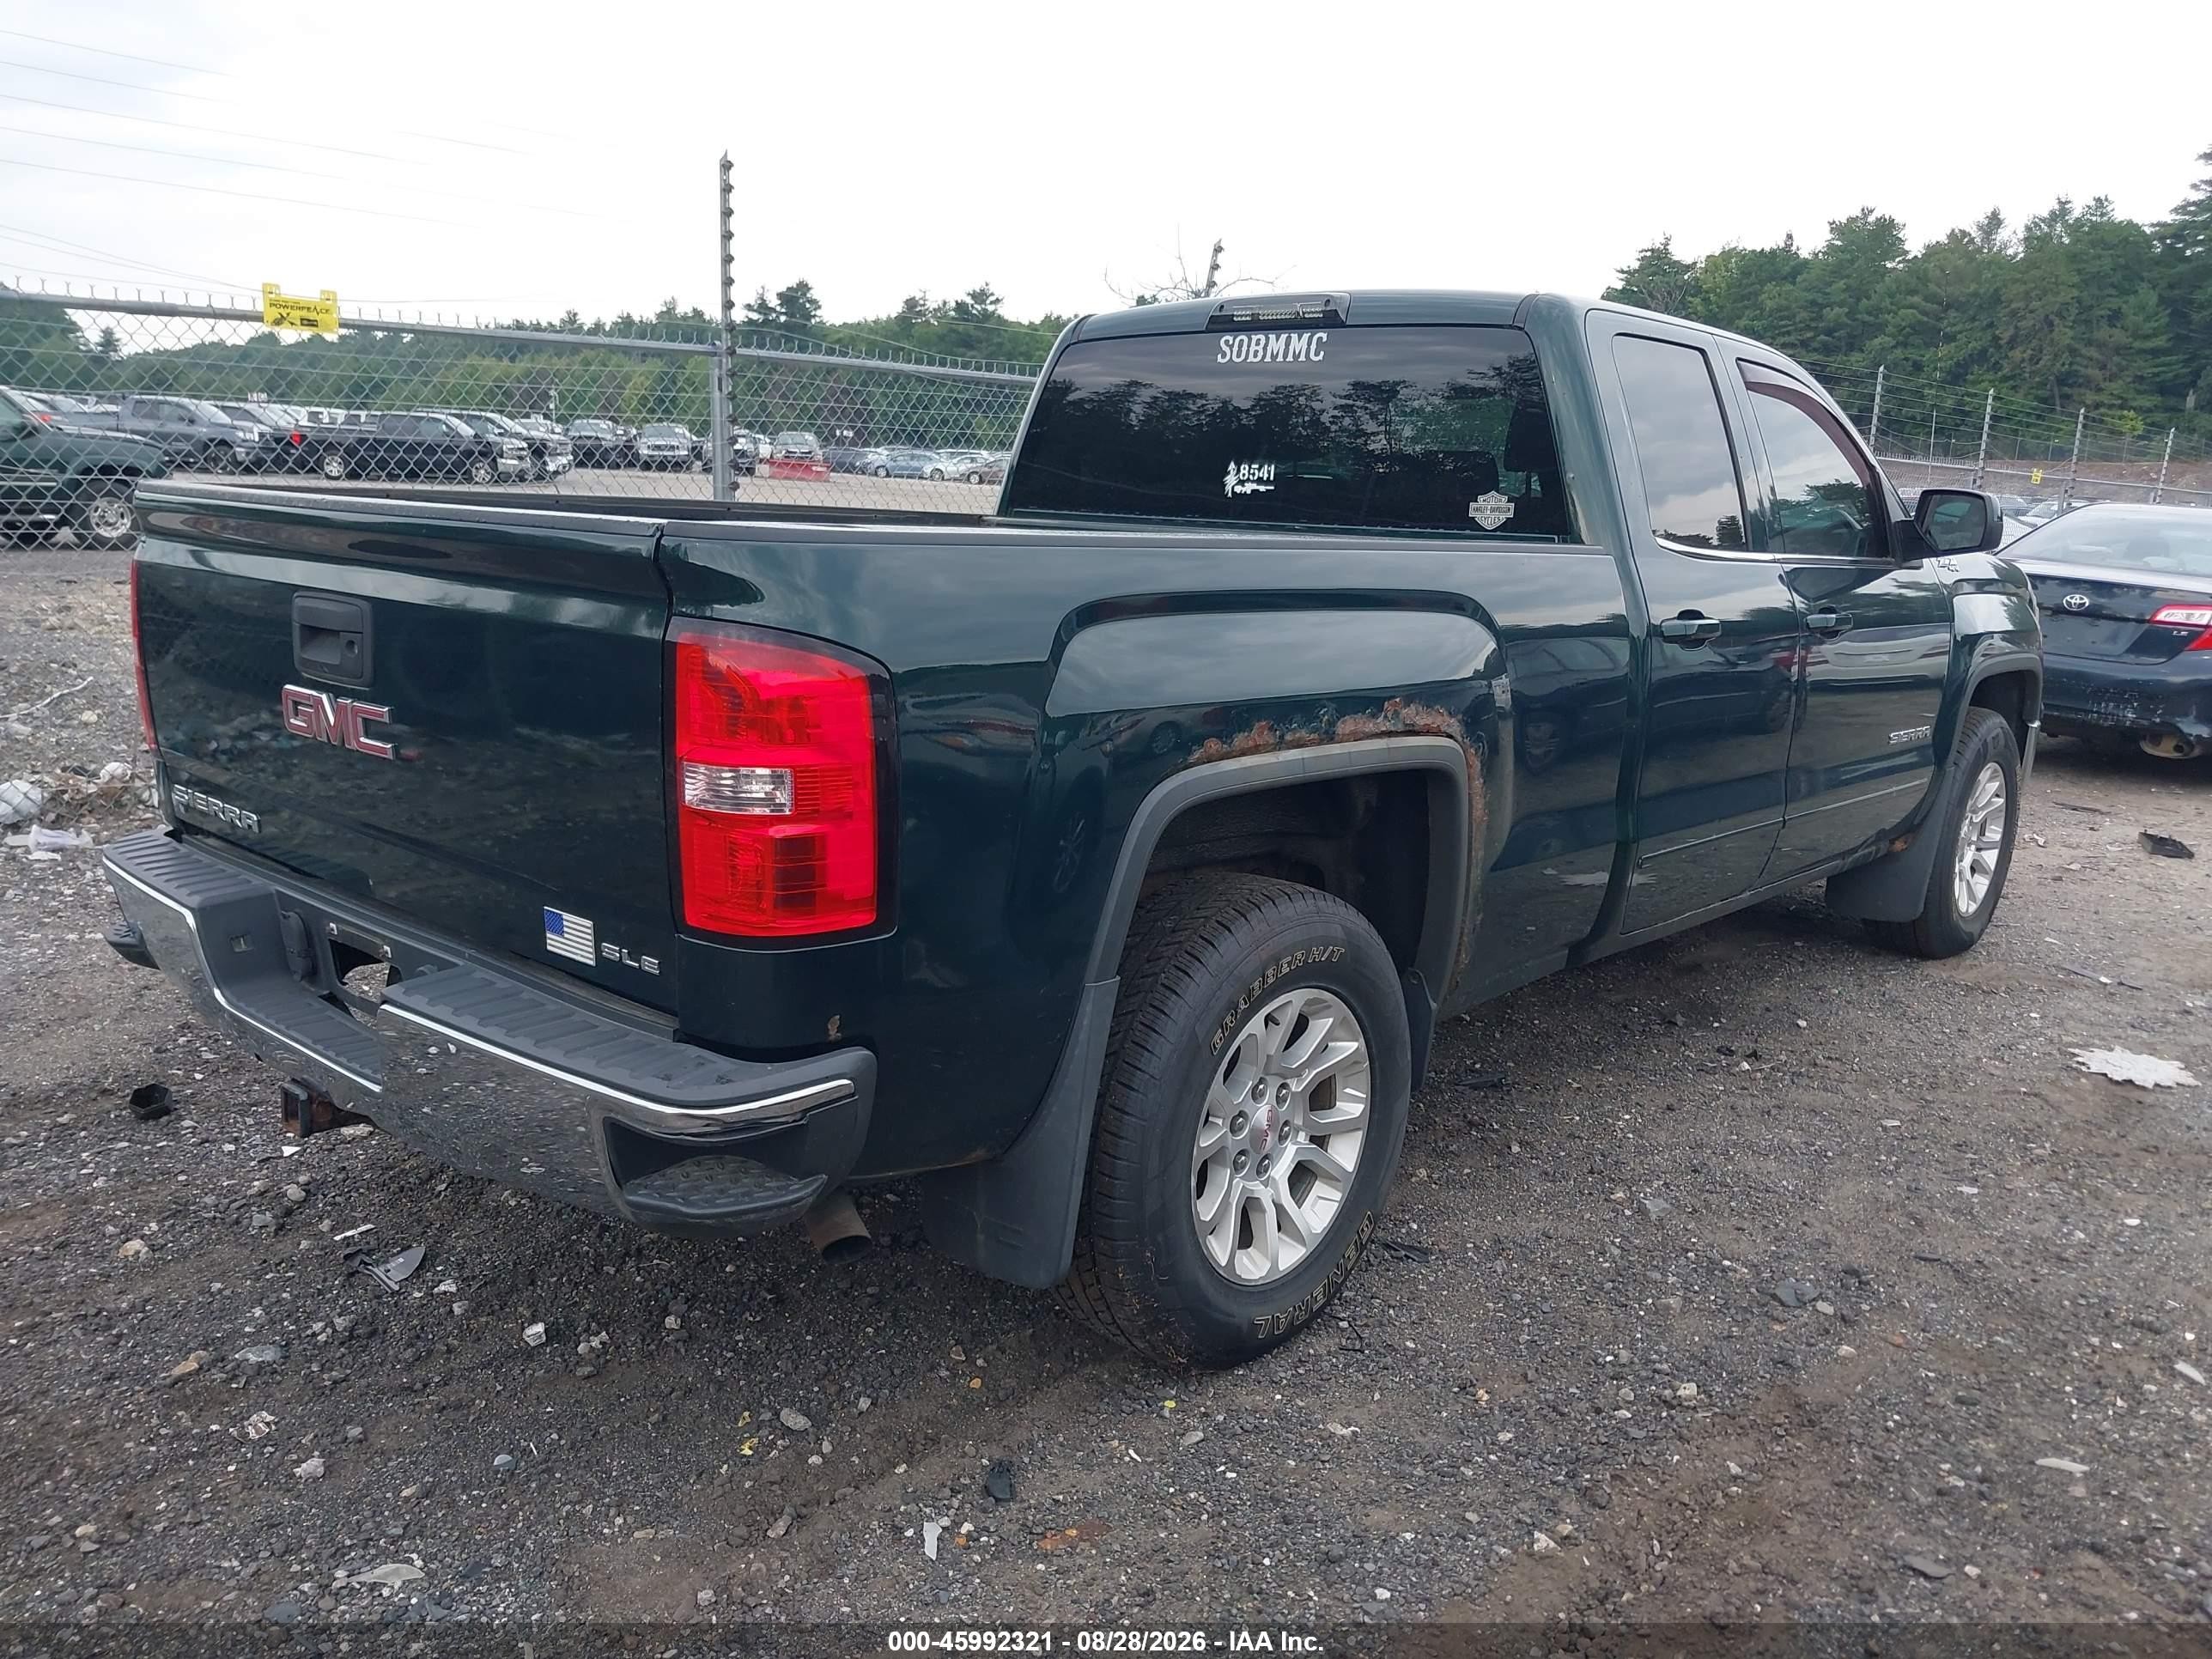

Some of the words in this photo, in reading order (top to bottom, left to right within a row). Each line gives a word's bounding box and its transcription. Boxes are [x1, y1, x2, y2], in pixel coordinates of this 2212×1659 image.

[1217, 331, 1328, 363] SOBMMC
[1239, 464, 1275, 481] 8541
[282, 684, 394, 760] GMC
[1888, 726, 1931, 744] SIERRA
[172, 784, 260, 834] SIERRA
[601, 942, 660, 975] SLE
[1211, 951, 1305, 1055] GRABBER
[1308, 946, 1345, 963] H/T
[1259, 1109, 1273, 1152] GMC
[1254, 1211, 1374, 1339] GENERAL
